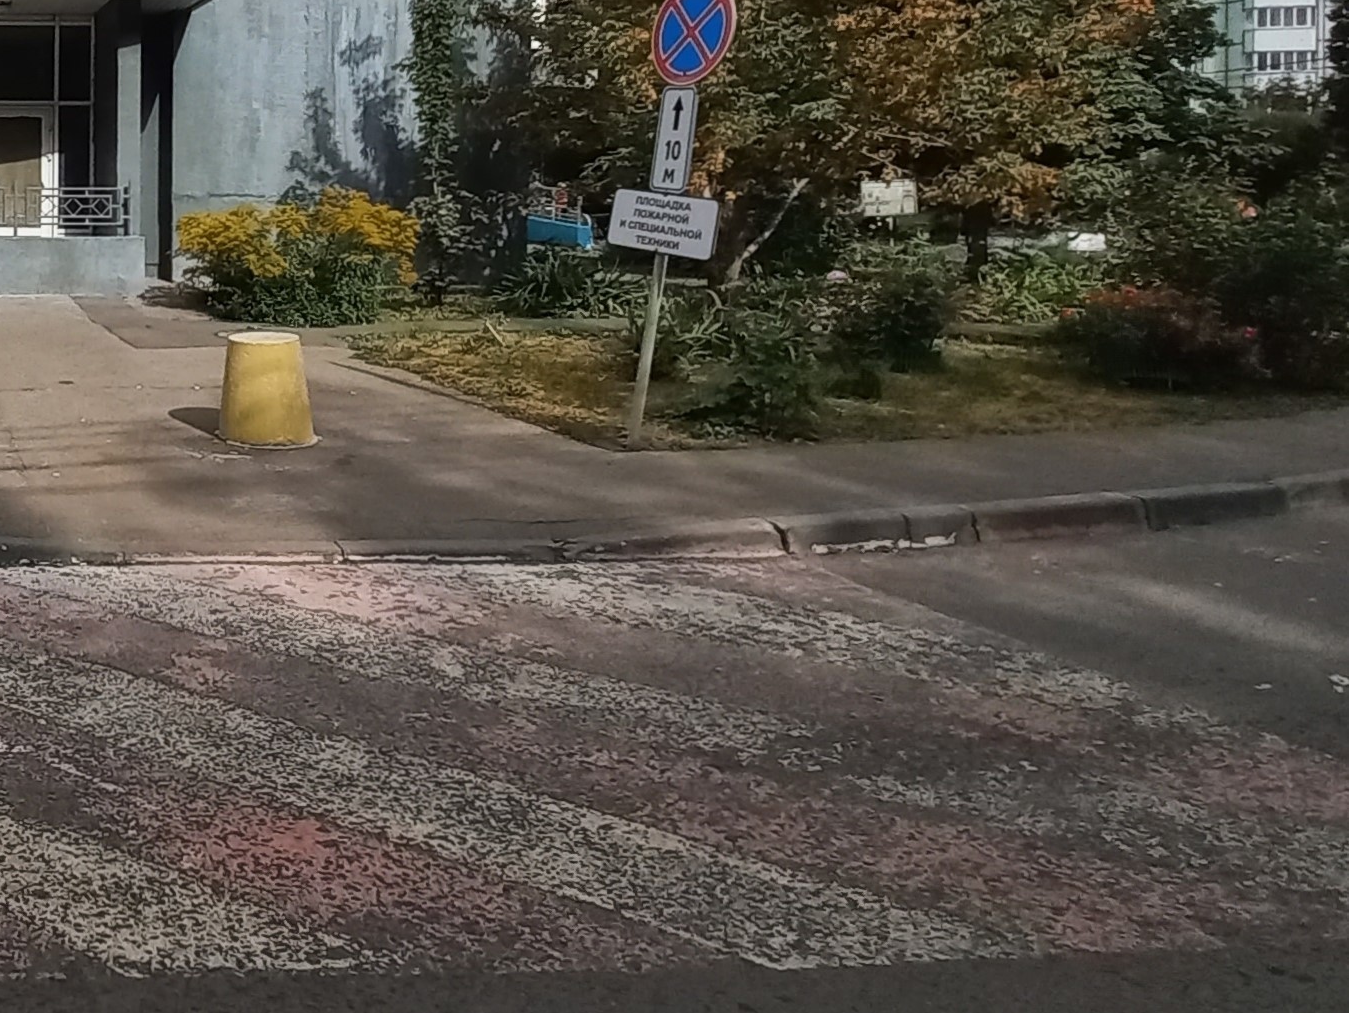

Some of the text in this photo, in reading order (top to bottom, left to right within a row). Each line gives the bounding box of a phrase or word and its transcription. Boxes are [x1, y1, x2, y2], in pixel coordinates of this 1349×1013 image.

[664, 140, 681, 161] 10
[635, 195, 692, 212] ПЛОЩАДКА
[633, 208, 690, 225] ПОЖАРНОЙ
[619, 219, 703, 240] И СПЕЦИАЛЬНОЙ
[634, 234, 681, 250] ТЕХНИКИ
